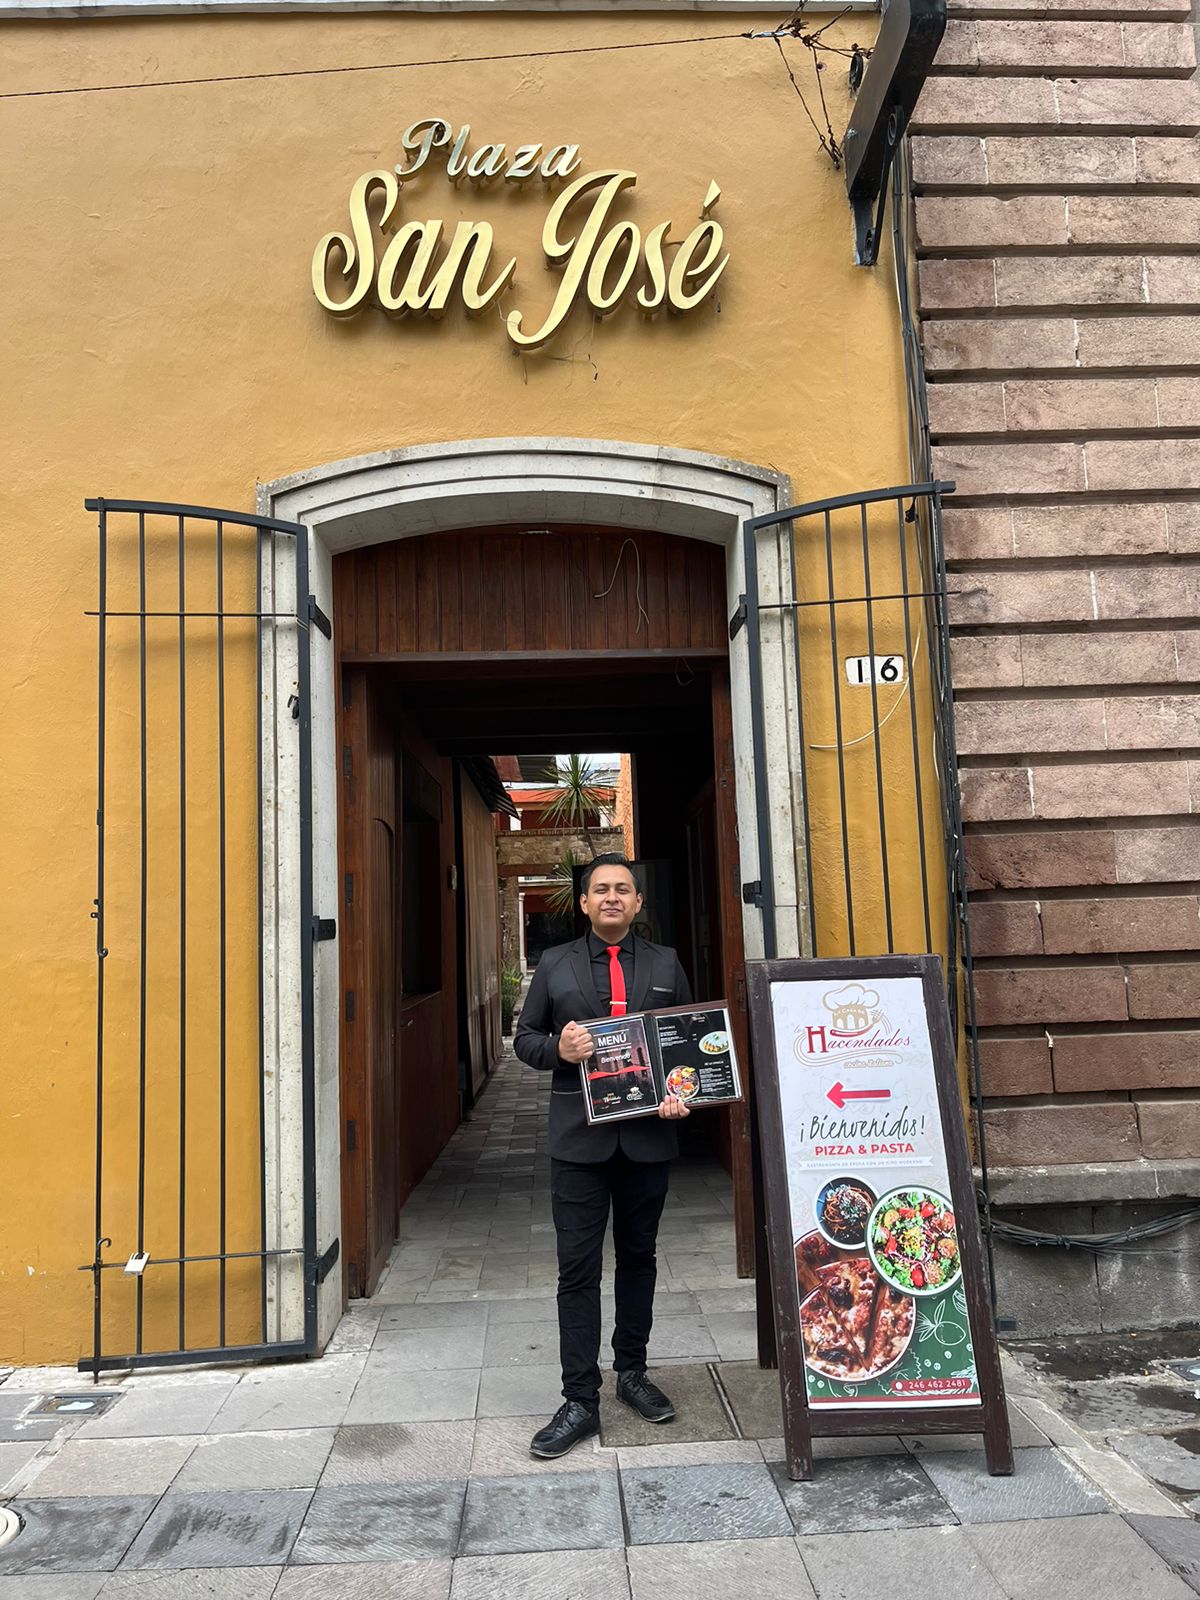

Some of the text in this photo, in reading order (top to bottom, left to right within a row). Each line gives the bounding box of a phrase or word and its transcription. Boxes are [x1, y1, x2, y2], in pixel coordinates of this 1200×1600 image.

[395, 118, 582, 178] Plaza
[312, 169, 730, 349] San José
[857, 657, 898, 682] 16
[597, 1032, 627, 1047] MENÚ
[805, 1026, 911, 1053] Hacendados
[800, 1105, 925, 1143] ¡Bienvenidos!
[815, 1143, 914, 1156] PIZZA & PASTA
[909, 1379, 965, 1389] 246 462 2481
